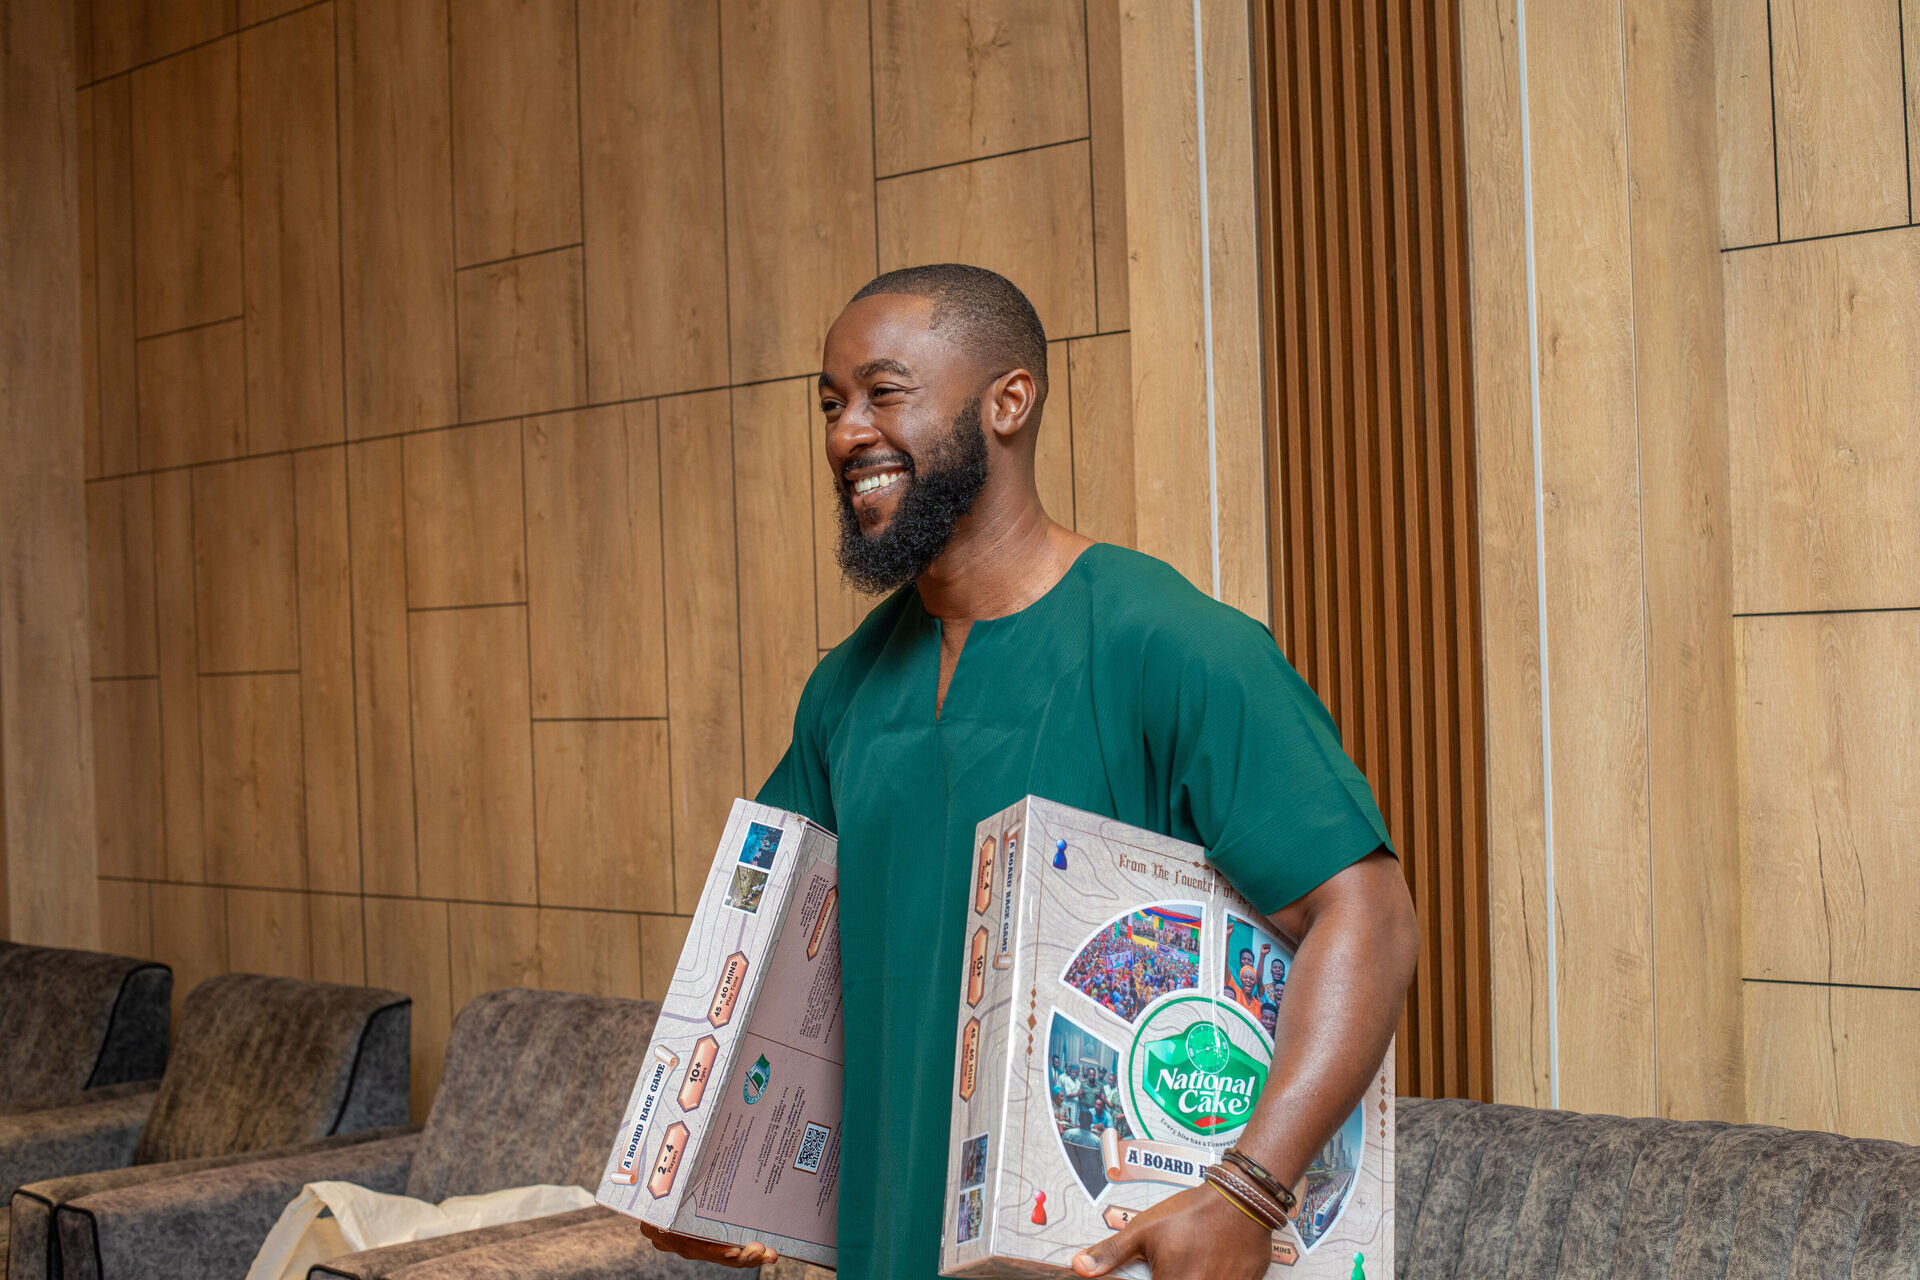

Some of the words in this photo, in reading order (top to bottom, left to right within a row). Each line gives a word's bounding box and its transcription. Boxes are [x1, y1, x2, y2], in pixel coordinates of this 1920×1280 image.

[985, 859, 992, 867] 2
[1006, 851, 1015, 887] BOARD
[1119, 853, 1146, 874] From
[1151, 861, 1169, 881] The
[1001, 922, 1009, 953] GAME
[714, 1007, 722, 1018] 45
[721, 987, 729, 999] 60
[726, 960, 738, 985] MINS
[725, 992, 734, 1006] Play
[730, 976, 739, 991] Time
[650, 1063, 666, 1092] GAME
[690, 1062, 702, 1083] 10+
[698, 1067, 708, 1083] Ages
[1155, 1068, 1256, 1097] National
[640, 1094, 655, 1122] RACE
[1178, 1089, 1250, 1115] Cake
[626, 1125, 644, 1159] BOARD
[623, 1161, 632, 1169] A
[658, 1166, 667, 1174] 2
[666, 1144, 674, 1153] 4
[667, 1150, 678, 1173] Players
[1128, 1149, 1138, 1164] A
[1143, 1152, 1194, 1175] BOARD
[1122, 1213, 1128, 1222] 2
[1273, 1245, 1292, 1255] MINS
